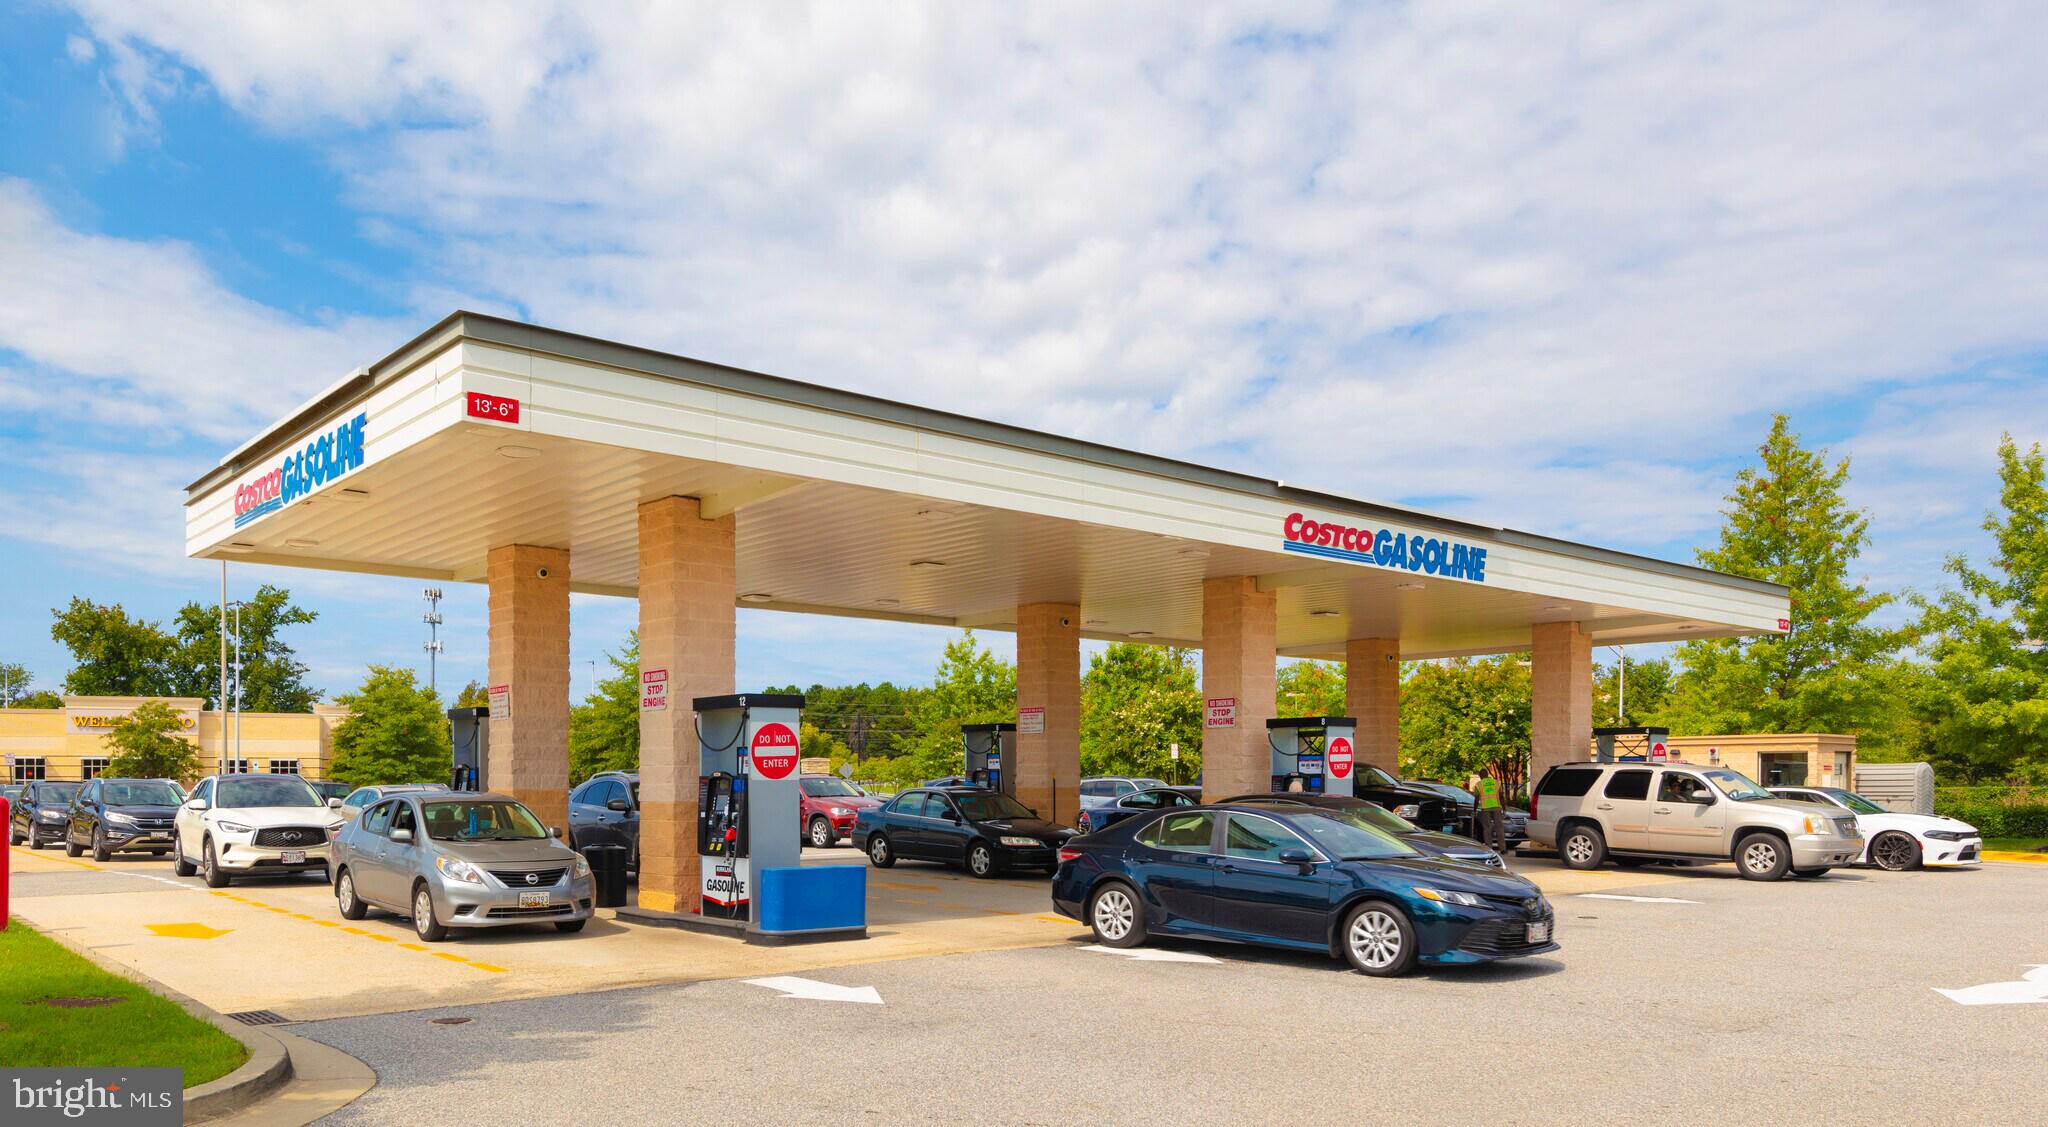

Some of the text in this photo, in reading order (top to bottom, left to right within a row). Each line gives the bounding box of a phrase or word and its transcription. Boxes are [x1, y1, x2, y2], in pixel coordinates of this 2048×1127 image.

[235, 411, 366, 516] COSTCO GASOLINE
[1284, 512, 1487, 582] COSTCO GASOLINE
[647, 684, 664, 695] STOP
[643, 696, 666, 707] ENGINE
[739, 696, 746, 706] 12
[1212, 708, 1231, 717] STOP
[1208, 717, 1234, 726] ENGINE
[759, 734, 791, 744] DO NOT
[1332, 745, 1349, 753] DO NOT
[763, 758, 789, 769] ENTER
[707, 879, 744, 893] GASOLNE
